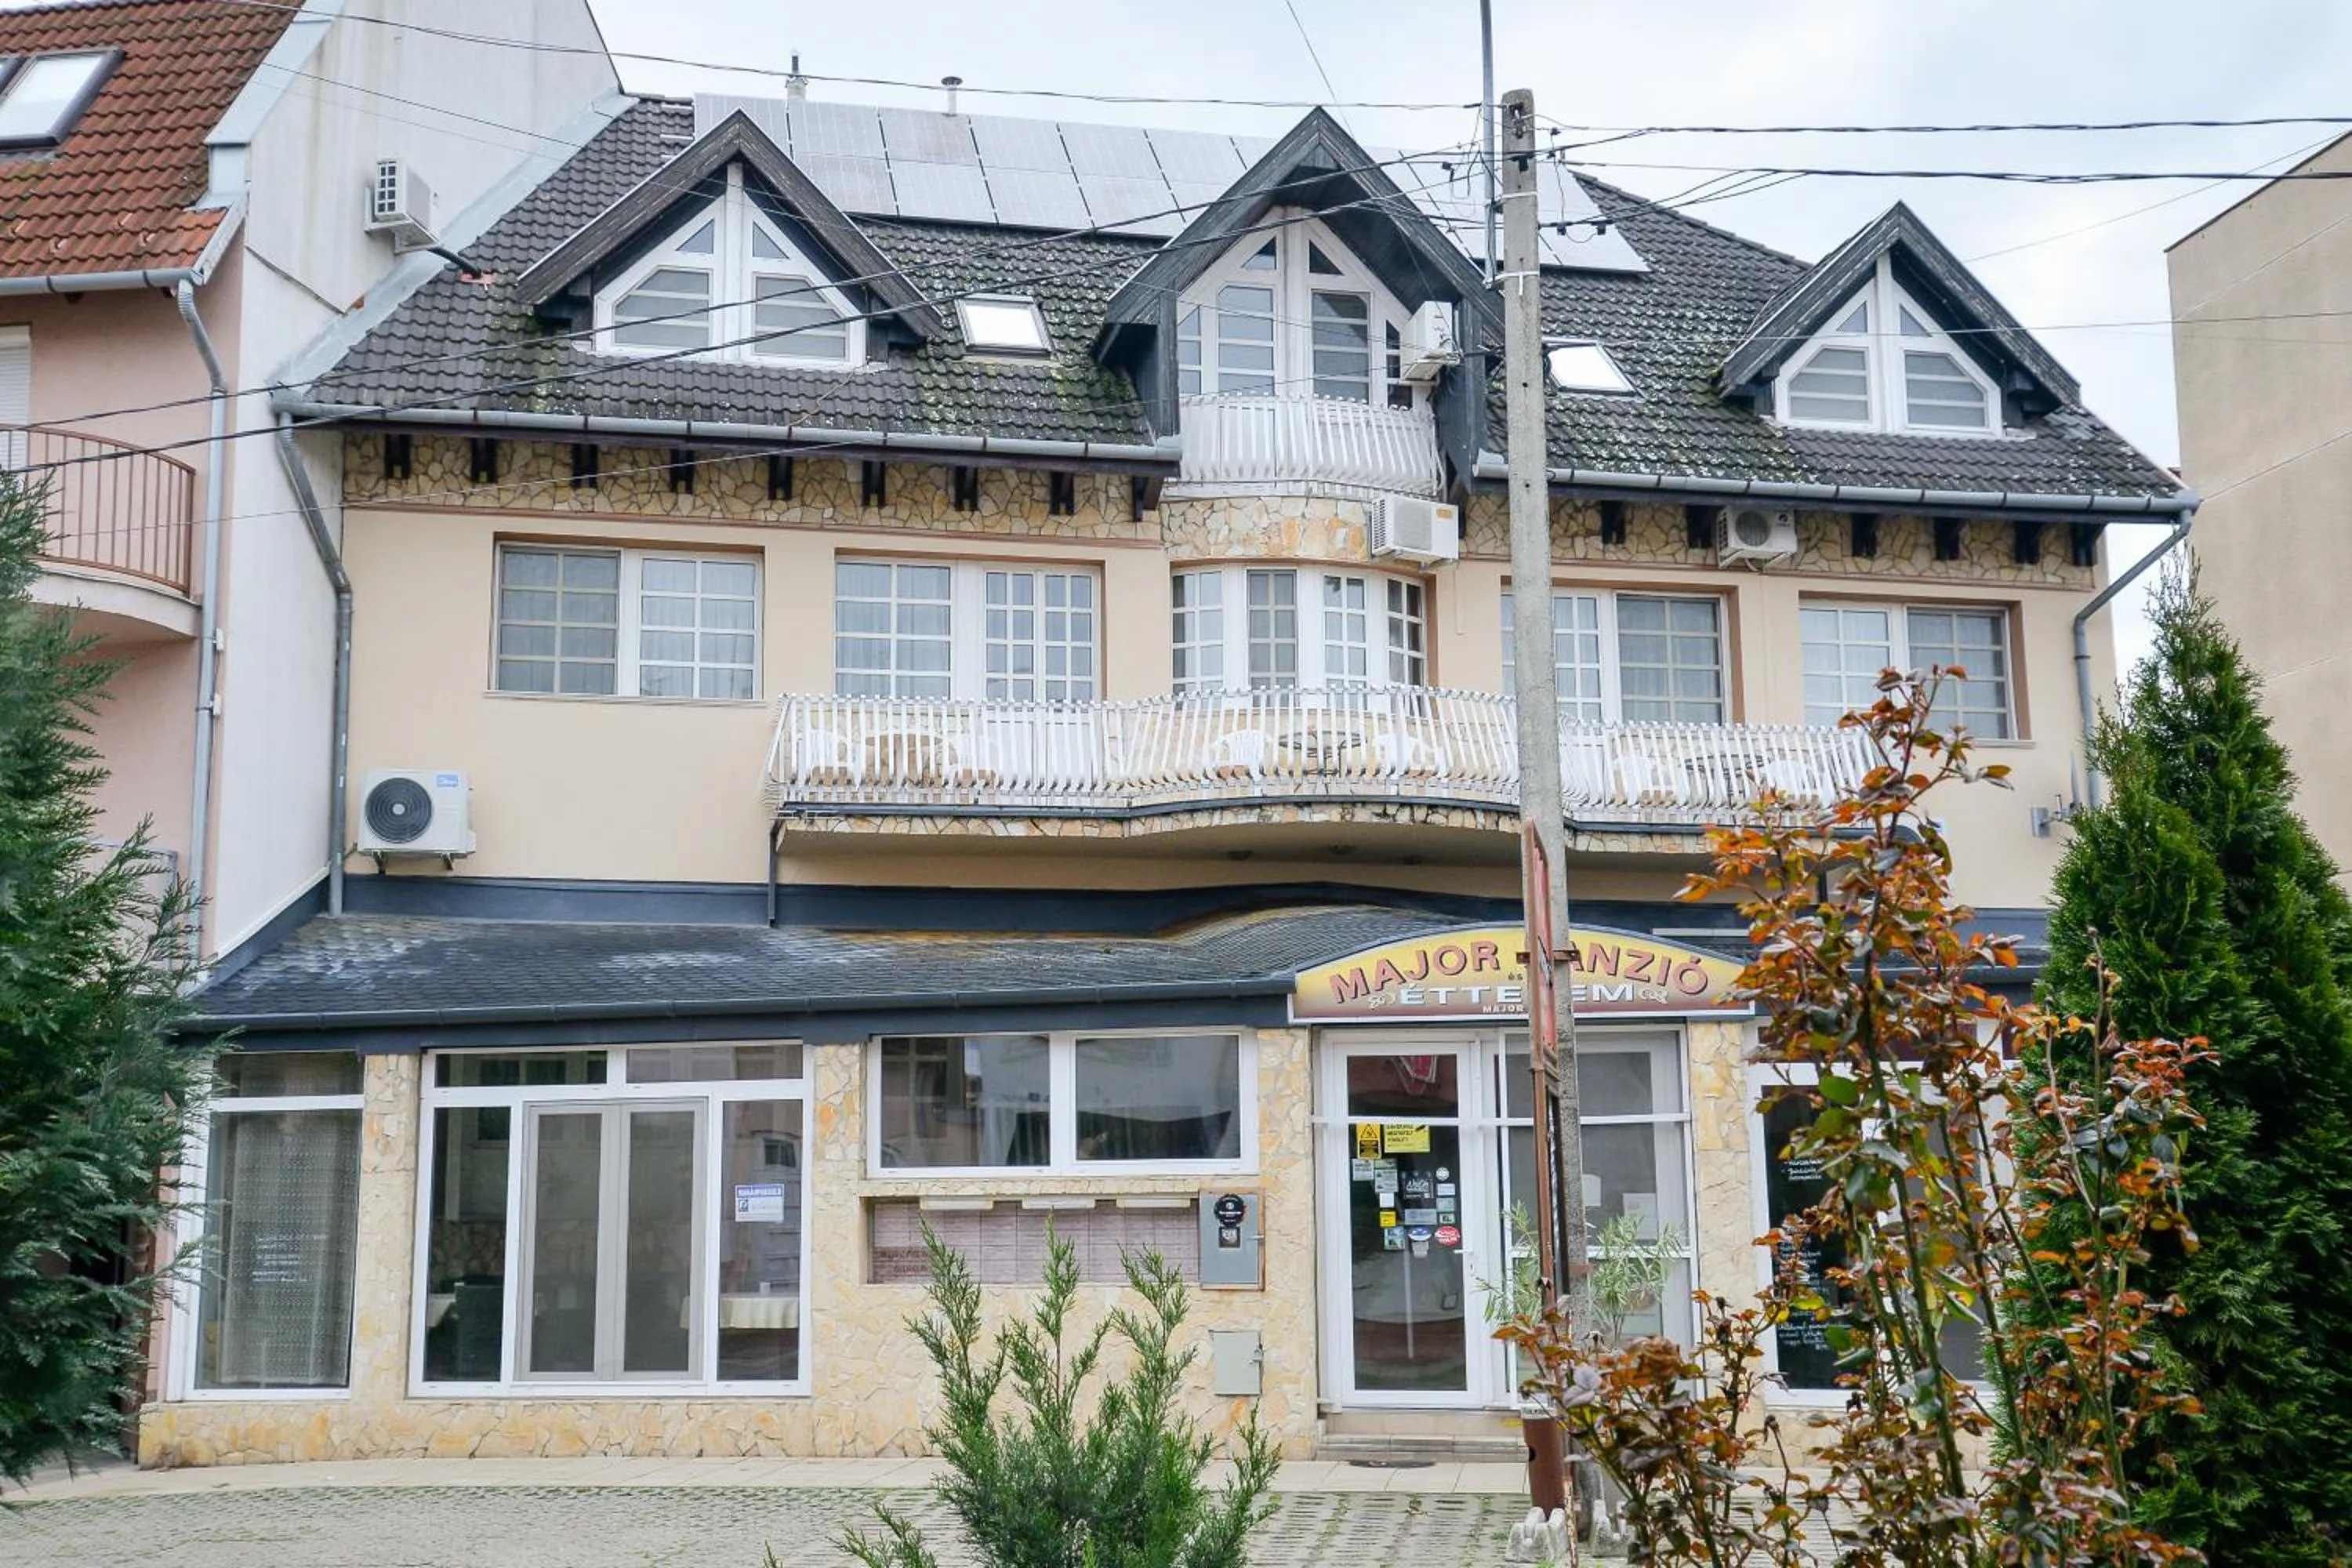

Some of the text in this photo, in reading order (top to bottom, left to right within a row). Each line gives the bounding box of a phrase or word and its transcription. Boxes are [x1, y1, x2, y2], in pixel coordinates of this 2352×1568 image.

[1330, 940, 1708, 1004] MAJOR NZIÓ
[1399, 982, 1635, 1006] ÉTTEEM
[1482, 1004, 1524, 1014] MAJOR
